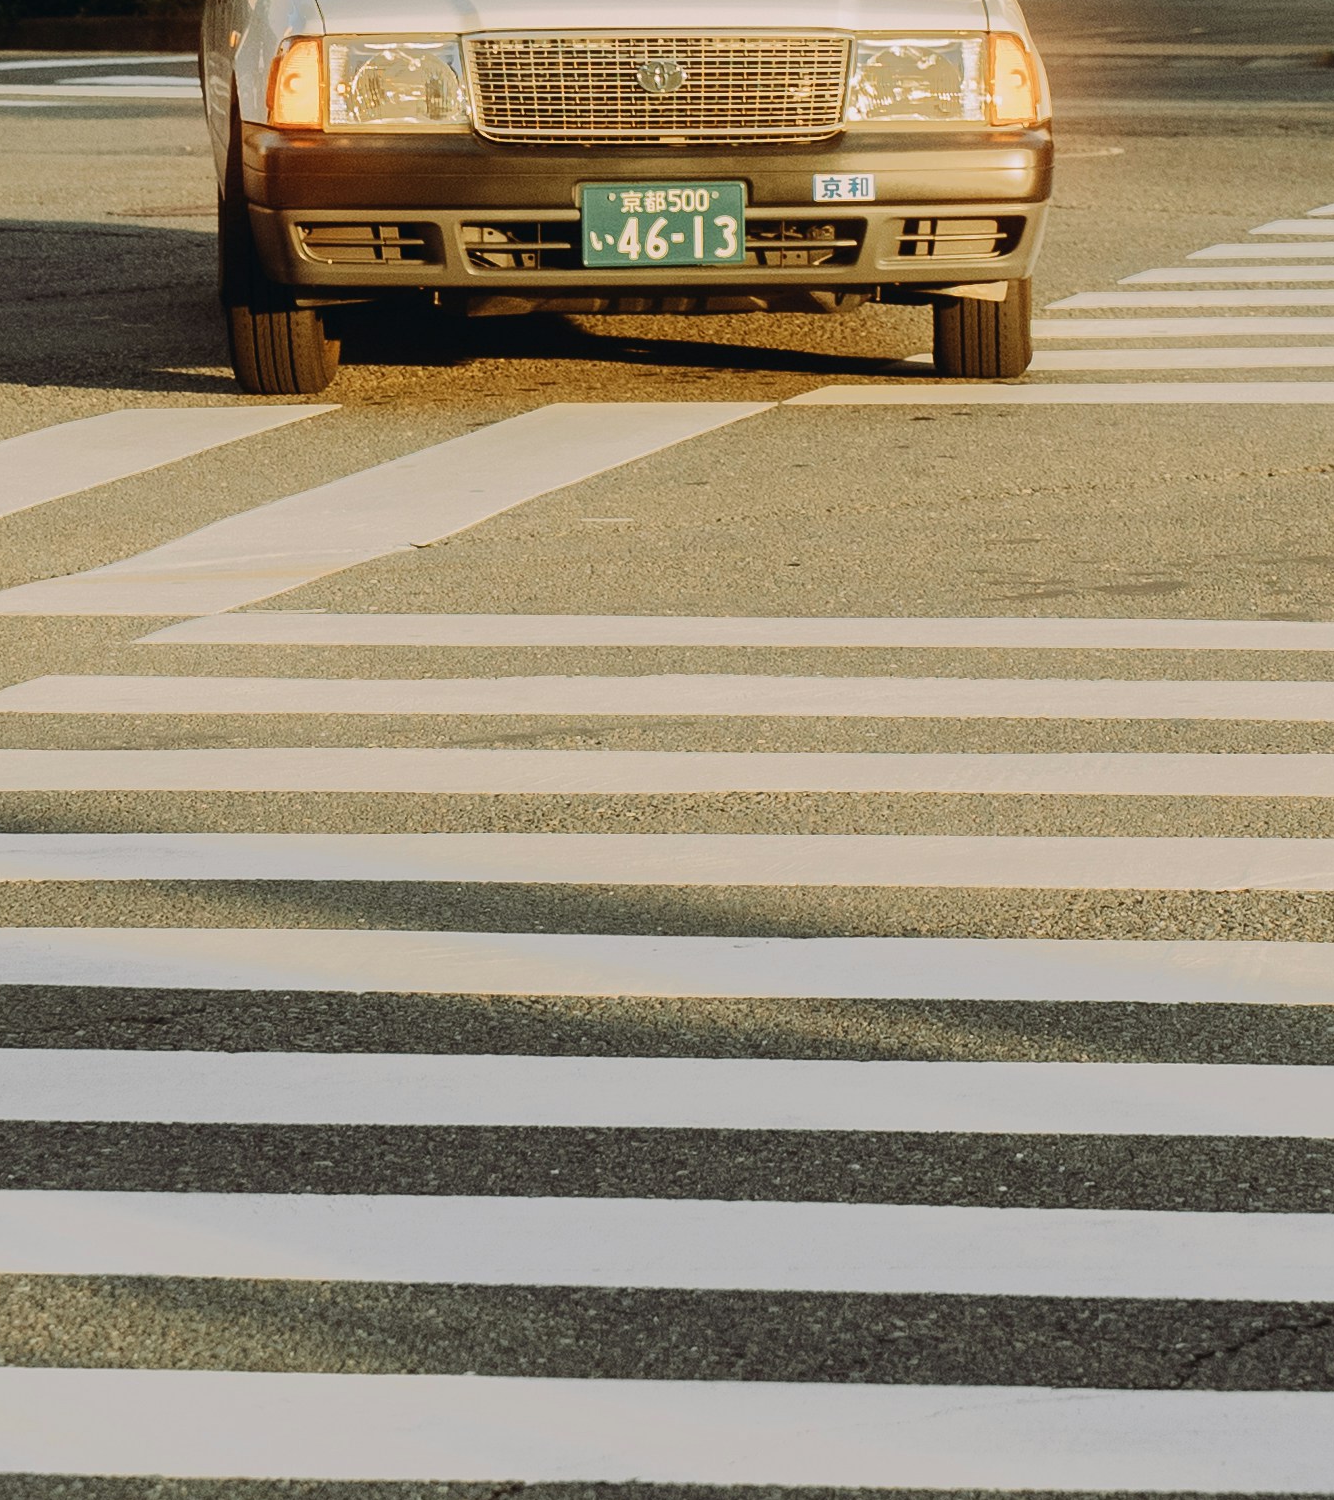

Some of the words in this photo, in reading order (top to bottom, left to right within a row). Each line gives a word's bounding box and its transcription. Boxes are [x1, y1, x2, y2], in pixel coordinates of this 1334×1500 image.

[619, 188, 710, 213] 京都500
[820, 177, 870, 199] 京和
[616, 215, 738, 261] 46-13
